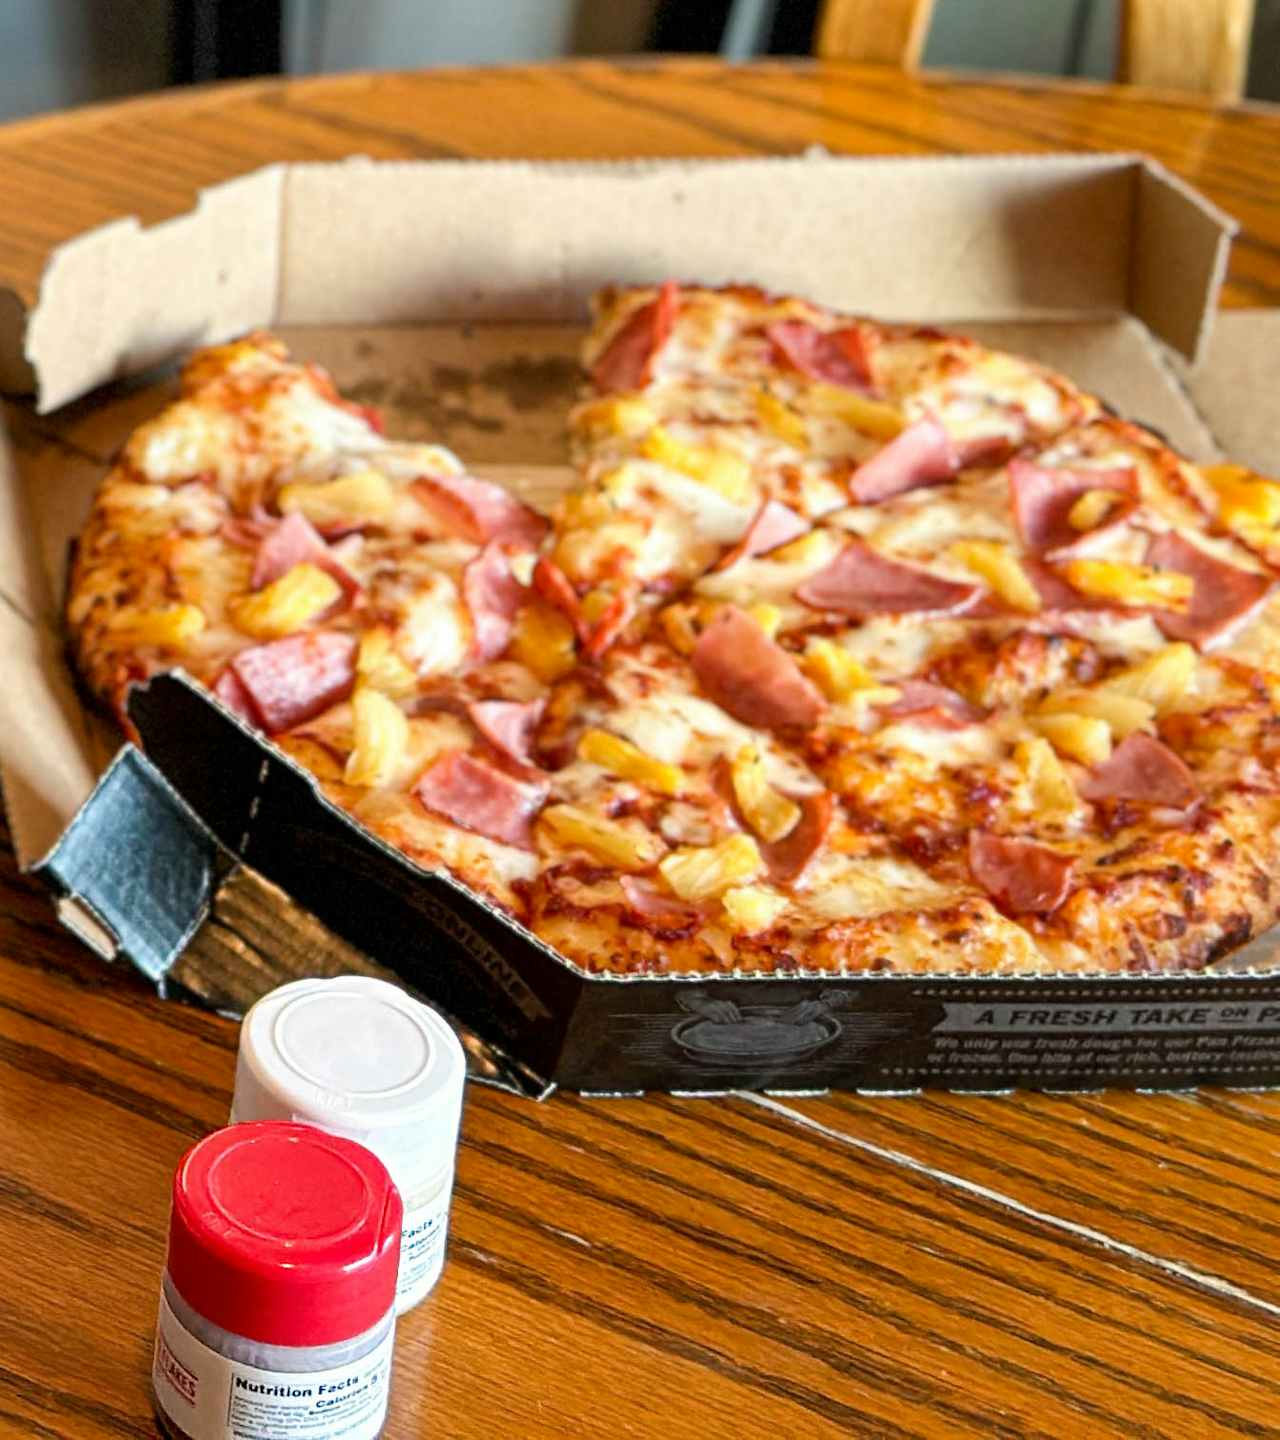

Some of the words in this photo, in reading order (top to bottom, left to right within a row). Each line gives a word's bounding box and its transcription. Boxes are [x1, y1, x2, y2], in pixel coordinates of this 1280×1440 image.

[974, 1009, 995, 1025] A
[1008, 1009, 1117, 1025] FRESH
[1130, 1008, 1211, 1024] TAKE
[1220, 1007, 1249, 1017] ON
[235, 1377, 312, 1397] Nutrition
[318, 1375, 359, 1395] Facts
[316, 1385, 369, 1408] Calories
